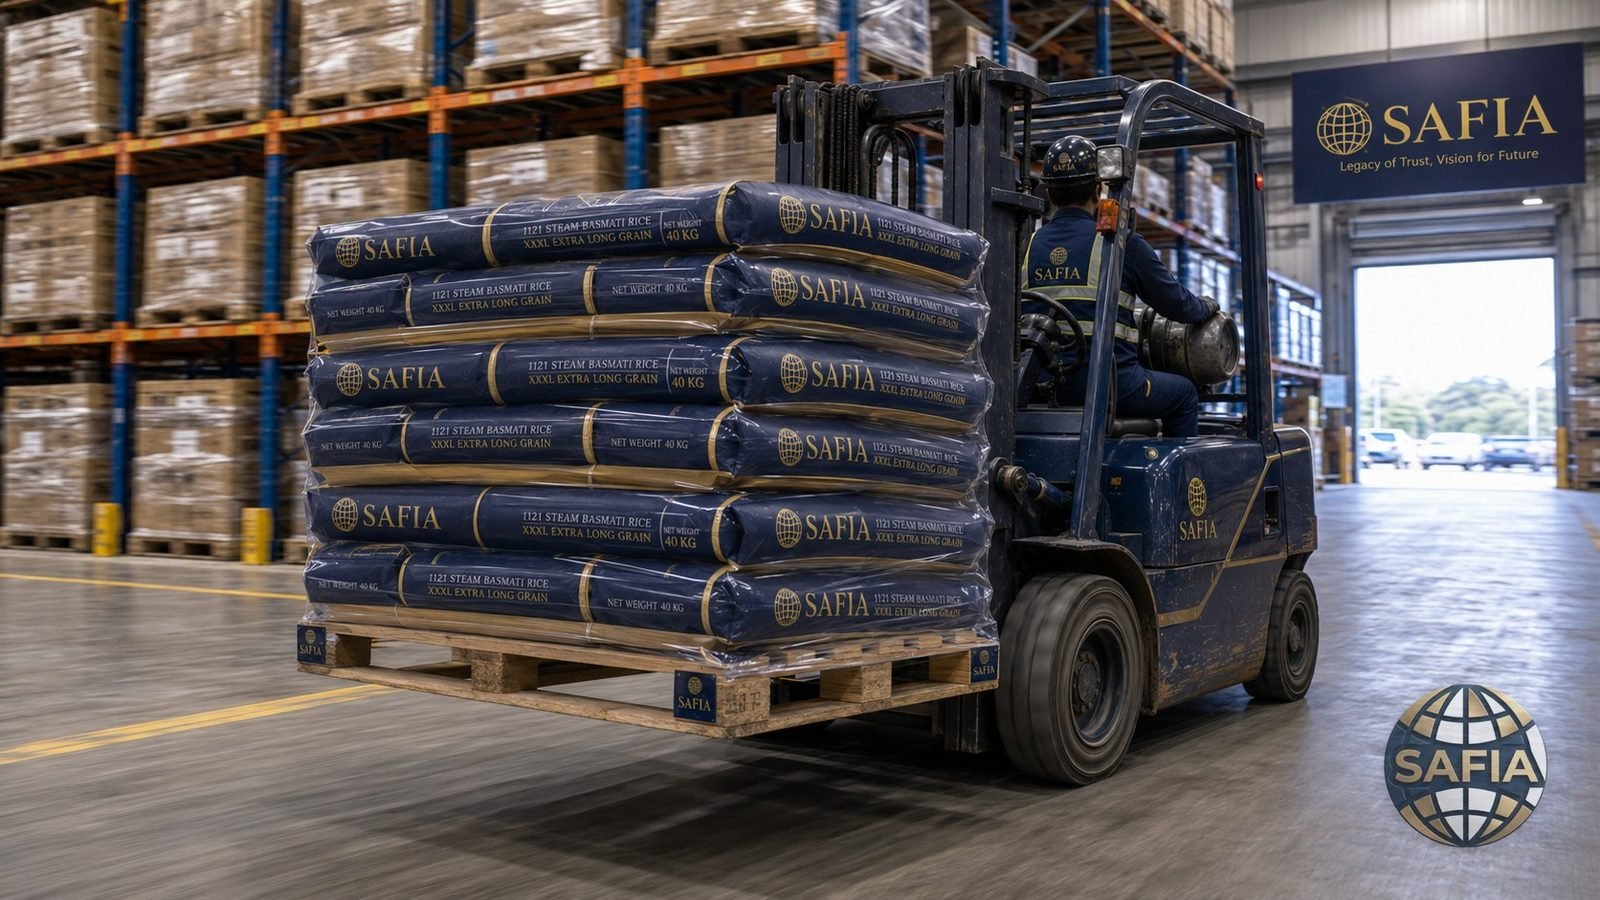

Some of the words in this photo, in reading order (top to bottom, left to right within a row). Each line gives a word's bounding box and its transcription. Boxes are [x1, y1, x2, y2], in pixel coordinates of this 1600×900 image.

[1383, 94, 1558, 146] SAFIA
[1340, 160, 1380, 173] Legacy
[1384, 157, 1397, 168] of
[1400, 156, 1433, 168] Trust,
[1436, 154, 1473, 165] Vision
[1477, 152, 1494, 162] for
[1498, 149, 1539, 160] Future
[523, 226, 542, 235] 1121
[545, 223, 580, 233] STEAM
[583, 218, 625, 229] BASMATI
[628, 216, 652, 225] RICE
[677, 219, 701, 228] WEIGHT
[810, 203, 873, 238] SAFIA
[523, 237, 550, 249] XXXL
[552, 234, 585, 247] EXTRA
[588, 232, 616, 244] LONG
[619, 230, 652, 240] GRAIN
[666, 230, 679, 241] 40
[682, 229, 699, 240] KG
[364, 235, 436, 261] SAFIA
[1035, 267, 1081, 281] SAFIA
[432, 291, 450, 299] 1121
[453, 288, 484, 298] STEAM
[486, 284, 527, 294] BASMATI
[530, 282, 552, 291] RICE
[612, 286, 628, 295] NET
[629, 284, 661, 294] WEIGHT
[664, 284, 675, 293] 40
[676, 283, 687, 292] KG
[800, 274, 866, 309] SAFIA
[327, 310, 340, 318] NET
[341, 307, 365, 316] WEIGHT
[375, 305, 385, 314] KG
[432, 303, 456, 312] XXXL
[459, 301, 489, 311] EXTRA
[492, 298, 518, 308] LONG
[520, 295, 552, 306] GRAIN
[529, 361, 548, 370] 1121
[551, 360, 585, 369] STEAM
[588, 359, 632, 369] BASMATI
[635, 359, 659, 369] RICE
[367, 366, 446, 390] SAFIA
[528, 375, 555, 384] XXXL
[557, 374, 590, 384] EXTRA
[593, 374, 622, 384] LONG
[625, 374, 658, 384] GRAIN
[672, 378, 685, 388] 40
[687, 378, 705, 389] KG
[811, 361, 875, 392] SAFIA
[431, 427, 450, 436] 1121
[452, 426, 484, 435] STEAM
[486, 425, 528, 434] BASMATI
[530, 425, 552, 434] RICE
[431, 440, 454, 449] XXXL
[458, 439, 488, 448] EXTRA
[491, 438, 518, 448] LONG
[520, 438, 551, 448] GRAIN
[611, 438, 627, 447] NET
[629, 438, 662, 448] WEIGHT
[664, 439, 675, 448] 40
[676, 440, 688, 449] KG
[806, 434, 869, 464] SAFIA
[363, 504, 442, 530] SAFIA
[523, 511, 542, 521] 1121
[545, 513, 579, 523] STEAM
[582, 515, 626, 526] BASMATI
[629, 517, 652, 528] RICE
[522, 525, 548, 536] XXXL
[551, 527, 584, 538] EXTRA
[586, 530, 615, 540] LONG
[618, 531, 651, 543] GRAIN
[676, 527, 700, 535] WEIGHT
[806, 514, 871, 541] SAFIA
[1179, 519, 1218, 541] SAFIA
[665, 537, 677, 547] 40
[680, 537, 697, 548] KG
[332, 581, 358, 590] WEIGHT
[360, 582, 368, 590] 40
[429, 574, 447, 583] 1121
[450, 574, 481, 584] STEAM
[484, 576, 524, 587] BASMATI
[527, 578, 549, 588] RICE
[428, 586, 452, 596] XXXL
[454, 587, 485, 598] EXTRA
[488, 590, 514, 600] LONG
[517, 591, 548, 602] GRAIN
[608, 599, 623, 608] NET
[624, 600, 658, 610] WEIGHT
[660, 601, 671, 611] 40
[672, 602, 685, 612] KG
[805, 592, 870, 618] SAFIA
[300, 644, 322, 656] SAFIA
[678, 696, 711, 712] SAFIA
